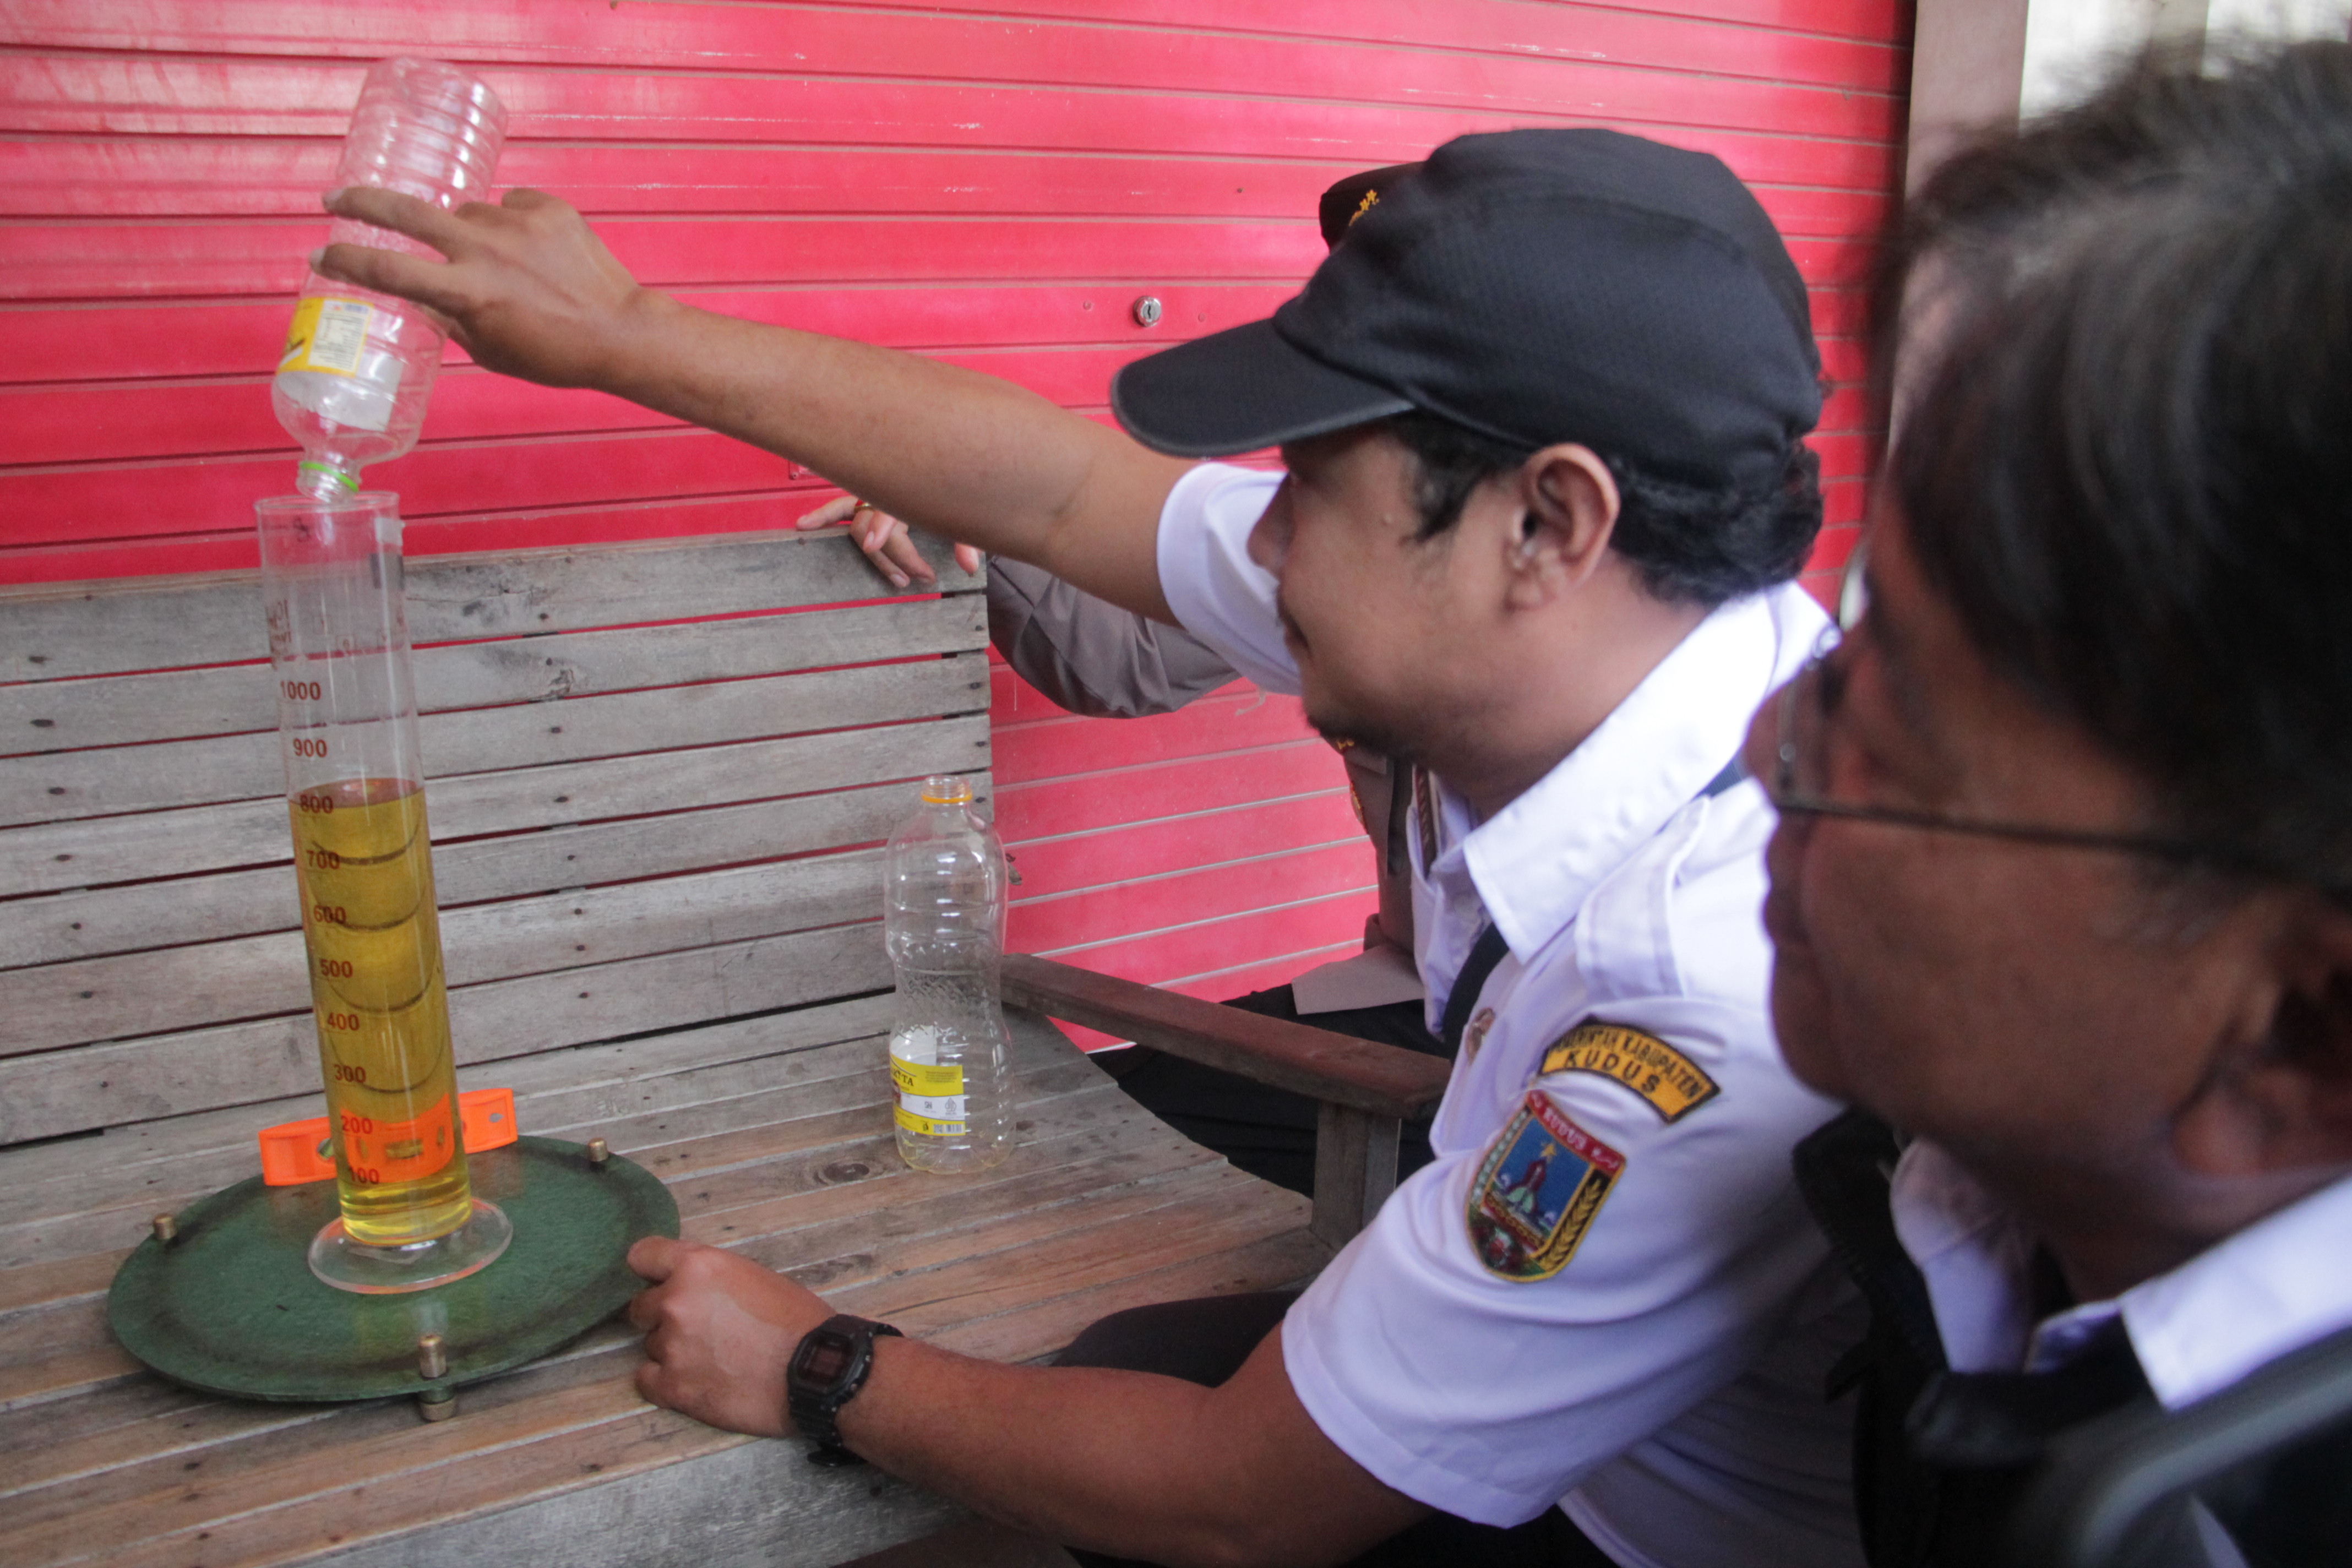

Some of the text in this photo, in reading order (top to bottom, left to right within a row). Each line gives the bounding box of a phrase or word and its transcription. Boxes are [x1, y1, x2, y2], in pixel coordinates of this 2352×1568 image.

[280, 680, 321, 700] 1000
[293, 738, 327, 758] 900
[300, 795, 334, 814] 800
[307, 850, 340, 870] 700
[313, 905, 346, 924] 600
[319, 959, 353, 978] 500
[326, 1012, 360, 1031] 400
[334, 1064, 367, 1084] 300
[1564, 1049, 1660, 1093] KUDUS
[341, 1115, 373, 1134] 200
[348, 1167, 379, 1184] 100
